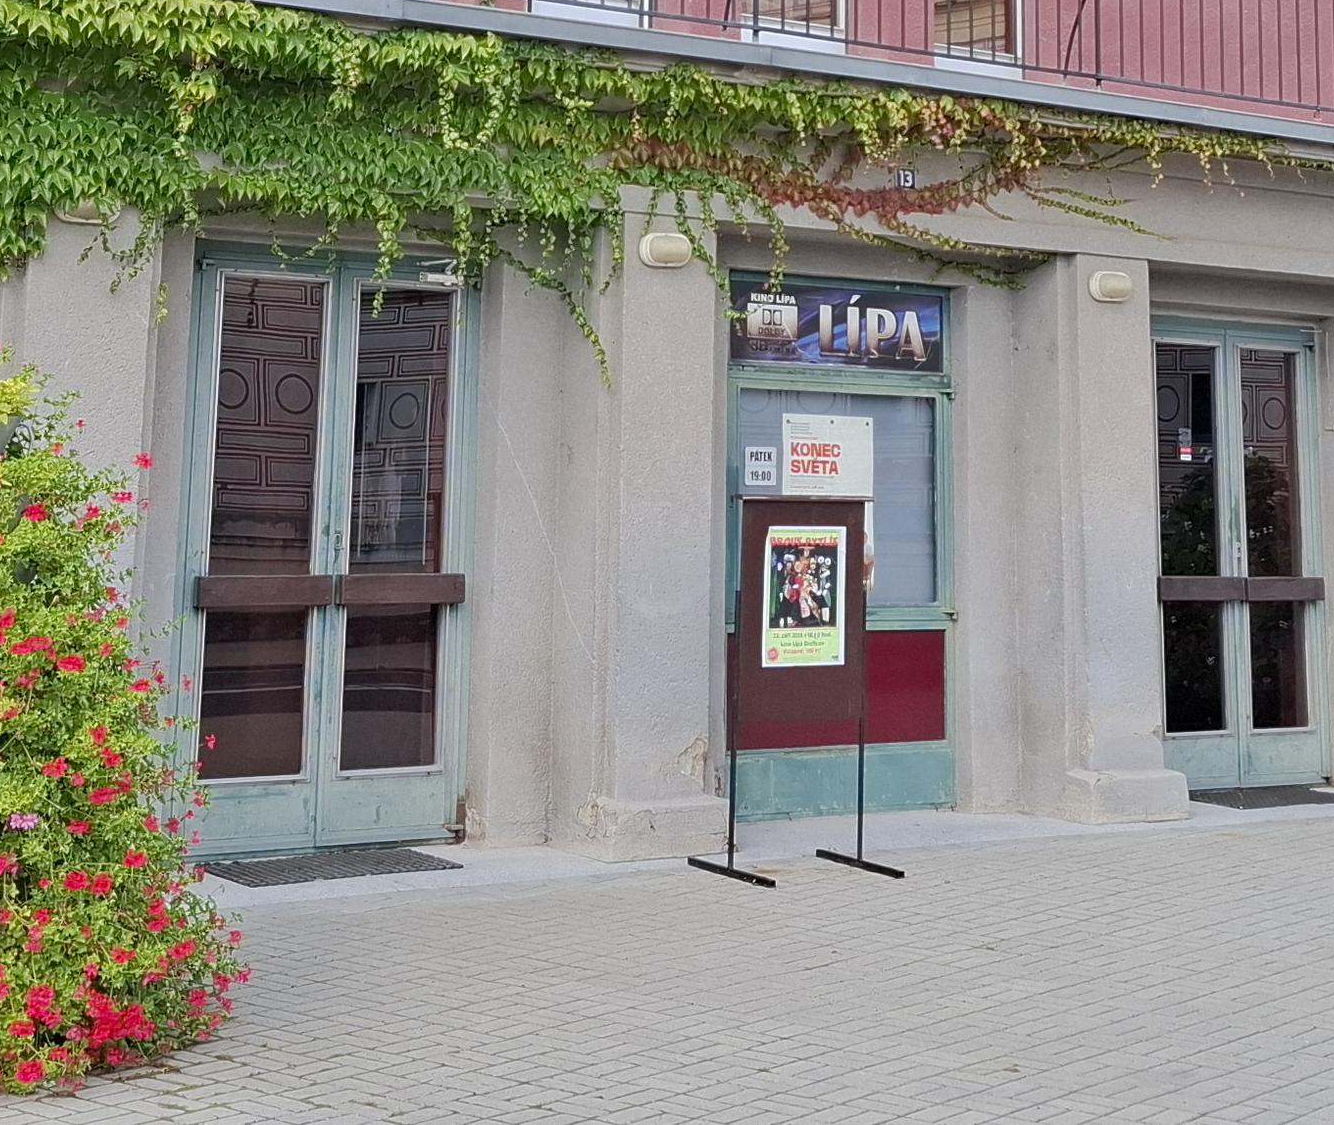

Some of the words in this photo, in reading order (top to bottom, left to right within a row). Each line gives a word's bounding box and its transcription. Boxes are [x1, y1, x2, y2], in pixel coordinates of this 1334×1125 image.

[900, 170, 913, 188] 13
[750, 292, 774, 303] KINO
[776, 293, 796, 305] LÍPA
[758, 327, 786, 336] DOLBY
[819, 294, 927, 362] LÍPA
[749, 450, 772, 462] PÁTEK
[790, 442, 841, 458] KONEC
[790, 457, 839, 475] SVĚTA
[750, 470, 772, 481] 19:00
